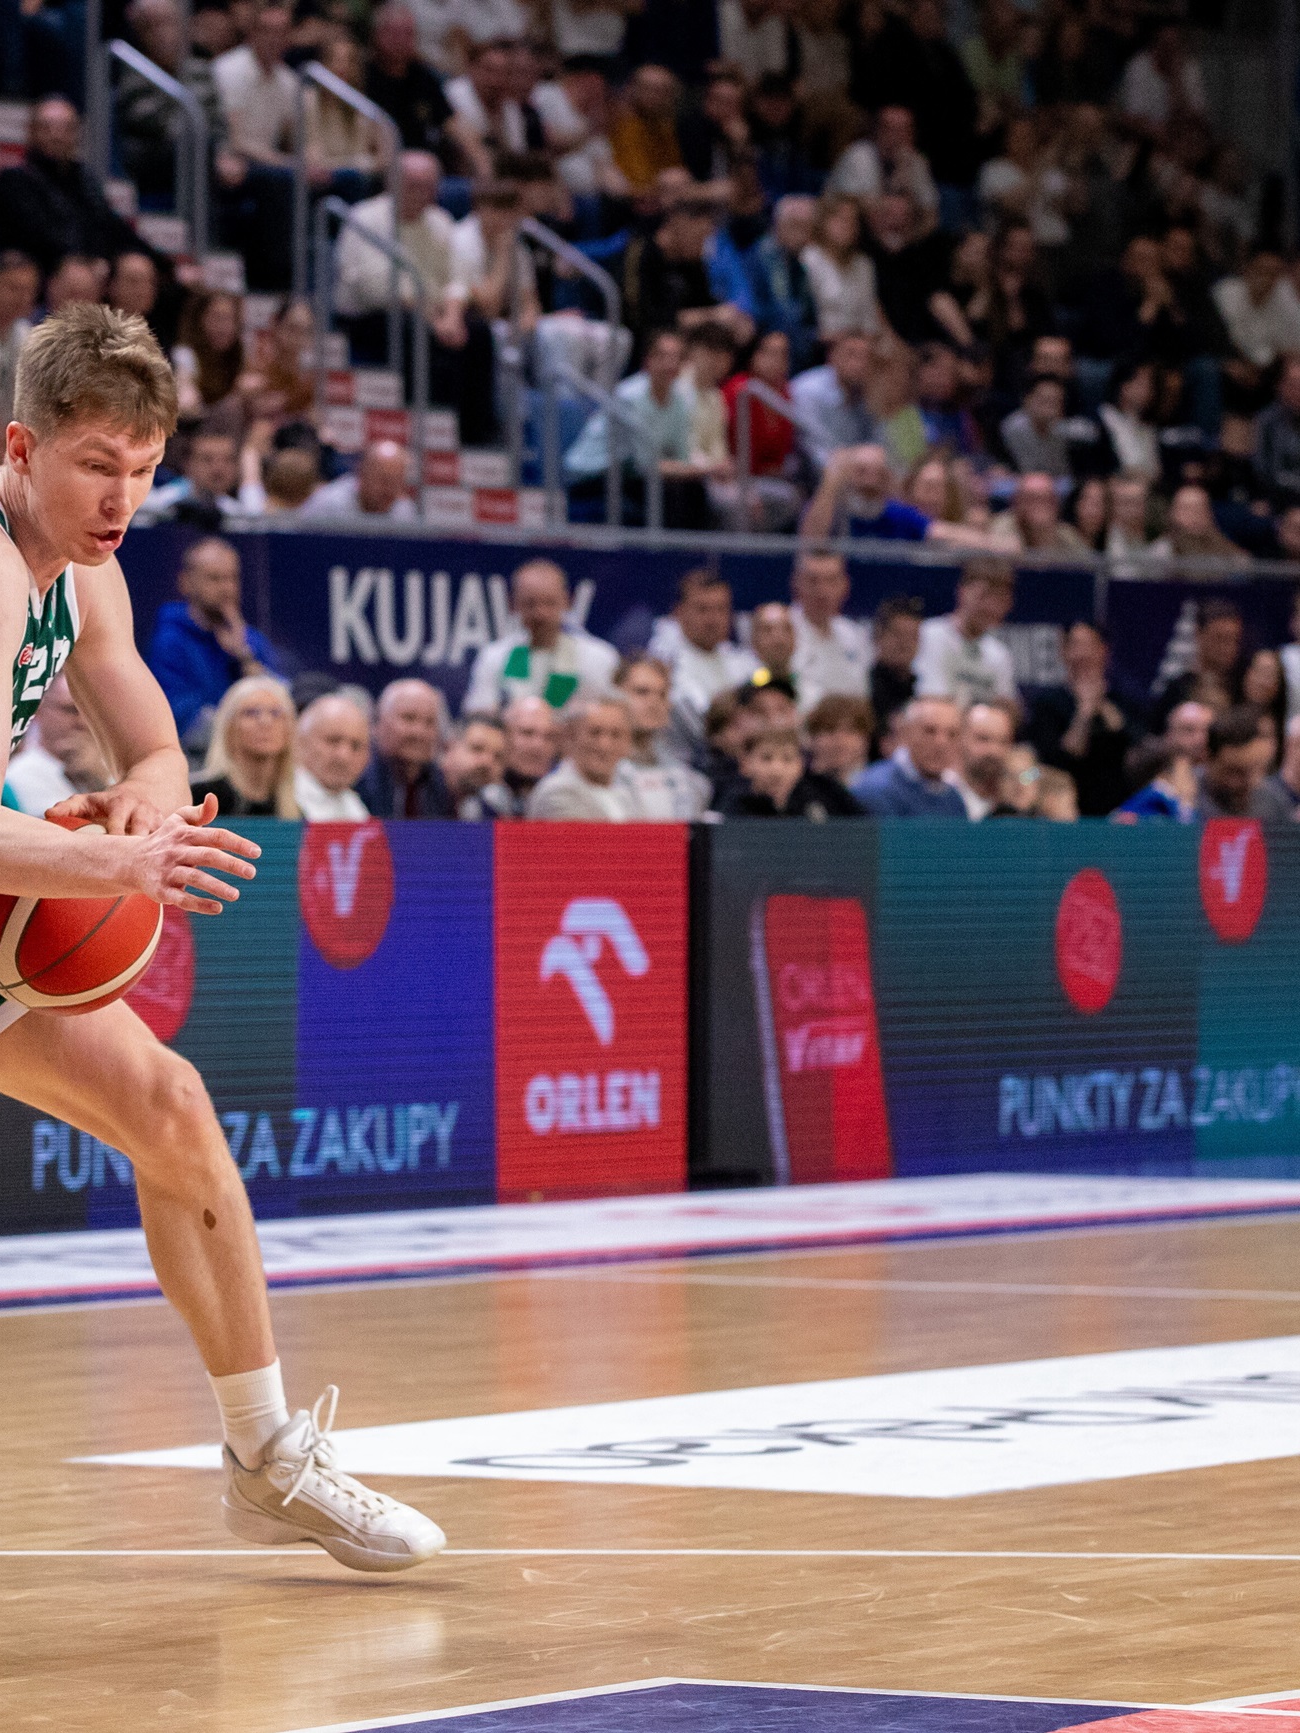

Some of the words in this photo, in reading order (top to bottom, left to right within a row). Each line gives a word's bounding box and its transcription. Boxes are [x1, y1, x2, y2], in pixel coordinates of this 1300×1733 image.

[525, 1070, 661, 1136] ORLEN
[32, 1118, 136, 1192] PUN
[289, 1101, 459, 1177] ZAKUPY
